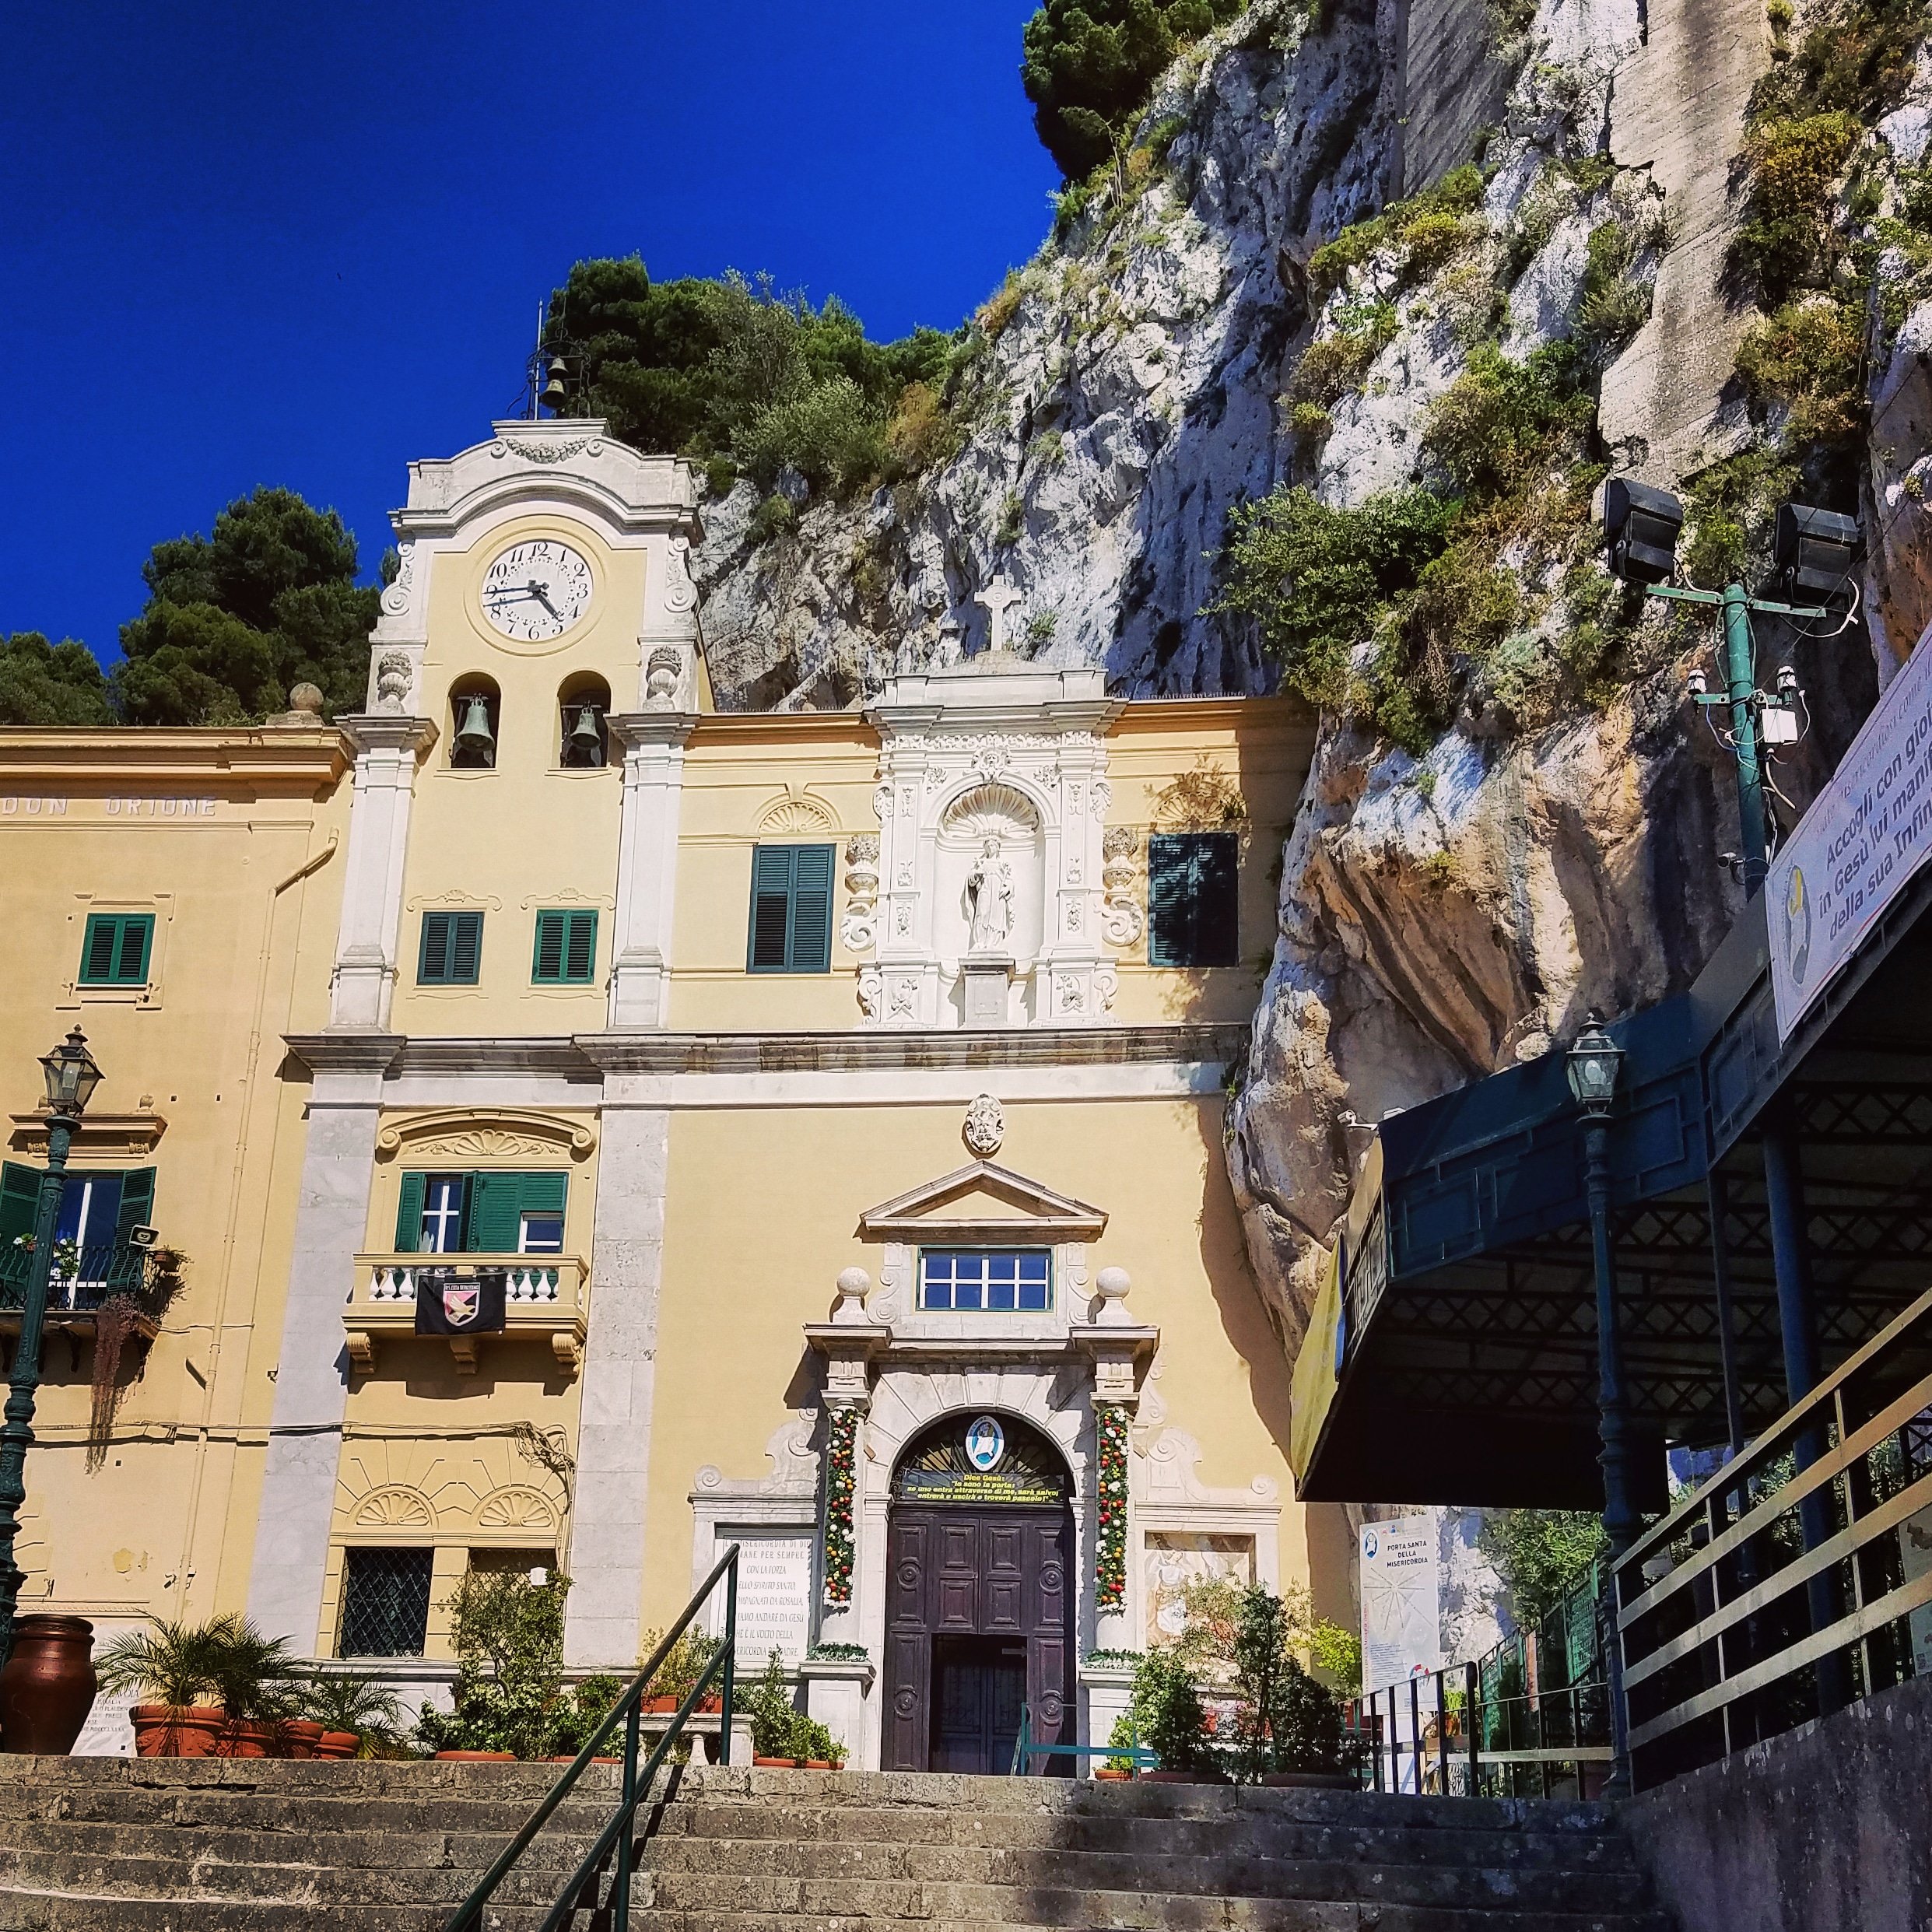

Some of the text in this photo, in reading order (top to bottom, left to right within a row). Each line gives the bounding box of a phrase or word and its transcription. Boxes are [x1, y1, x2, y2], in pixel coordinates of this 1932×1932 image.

[510, 549, 524, 563] 11
[531, 542, 549, 557] 12
[560, 548, 567, 563] 1
[489, 563, 507, 579] 10
[573, 563, 587, 577] 2
[486, 584, 498, 599] 9
[577, 584, 588, 598] 3
[490, 604, 501, 620] 8
[568, 604, 582, 619] 4
[507, 619, 517, 634] 7
[528, 625, 540, 640] 6
[552, 617, 564, 635] 5
[1828, 701, 1932, 871] Accogli con gioi
[2, 795, 216, 817] DON ORIONE
[1819, 892, 1832, 919] in
[1835, 838, 1869, 896] Gesù
[1869, 807, 1888, 850] lui
[1830, 786, 1932, 941] della sua Infin
[1387, 1540, 1427, 1552] PORTA SANTA
[777, 1551, 805, 1559] SEMPRE
[1387, 1557, 1429, 1568] MISERICORDIA
